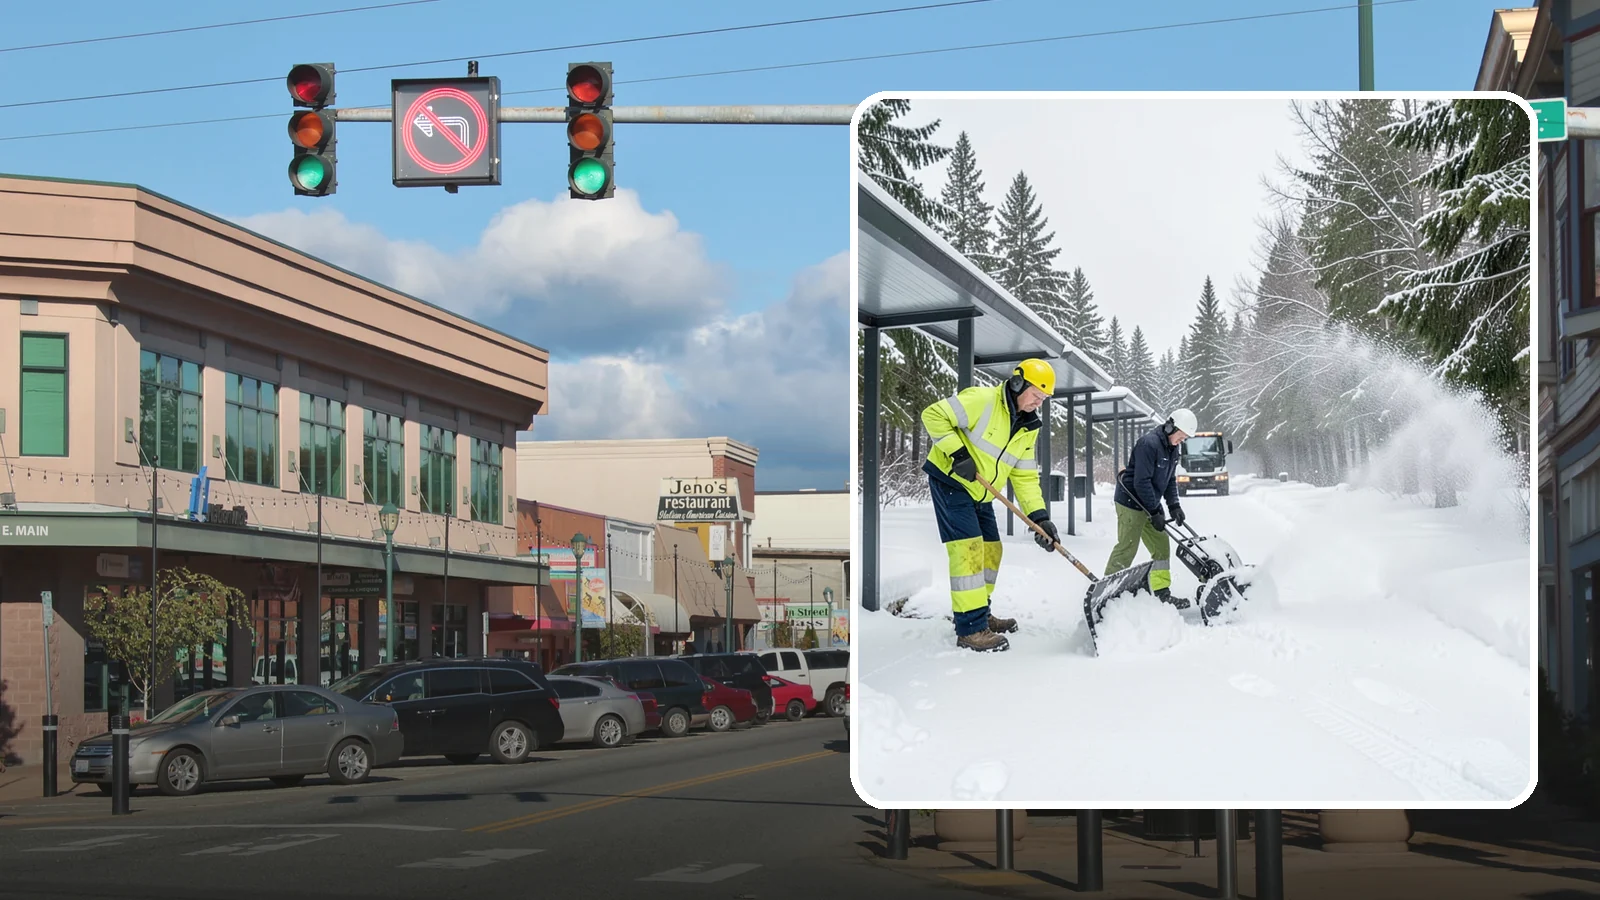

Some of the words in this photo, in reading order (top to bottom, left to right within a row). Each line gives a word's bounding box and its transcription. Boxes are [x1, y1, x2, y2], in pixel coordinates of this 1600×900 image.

[670, 480, 728, 495] Jeno's
[665, 496, 731, 509] restaurant
[658, 510, 681, 519] Italian
[685, 510, 714, 519] American
[714, 510, 737, 519] Cuisine
[2, 525, 13, 536] E.
[15, 525, 49, 536] MAIN
[797, 607, 828, 617] Street
